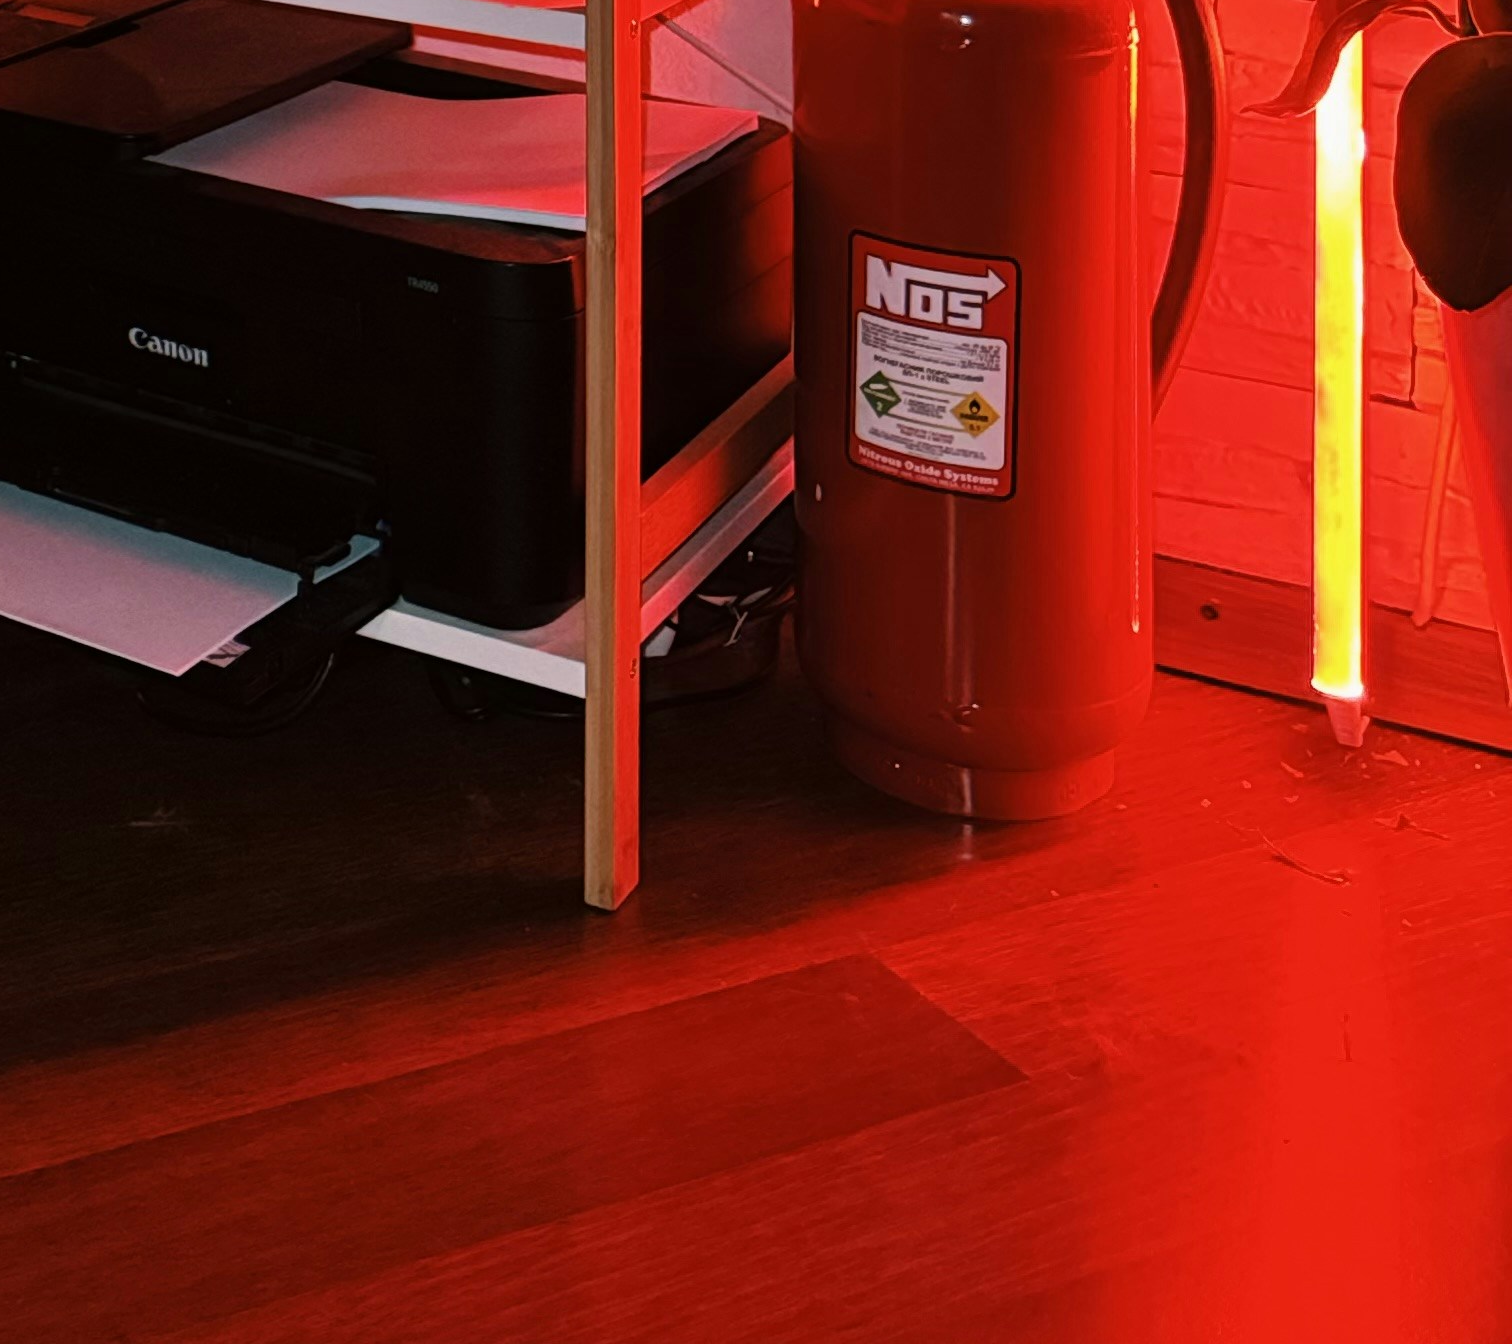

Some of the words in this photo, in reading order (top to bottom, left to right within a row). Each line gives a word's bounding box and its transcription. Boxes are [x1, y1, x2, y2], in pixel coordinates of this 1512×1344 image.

[866, 254, 985, 330] NOS
[128, 326, 209, 368] Canon
[858, 444, 902, 468] Nitrous
[904, 460, 941, 476] Oxide
[943, 469, 999, 486] Systems
